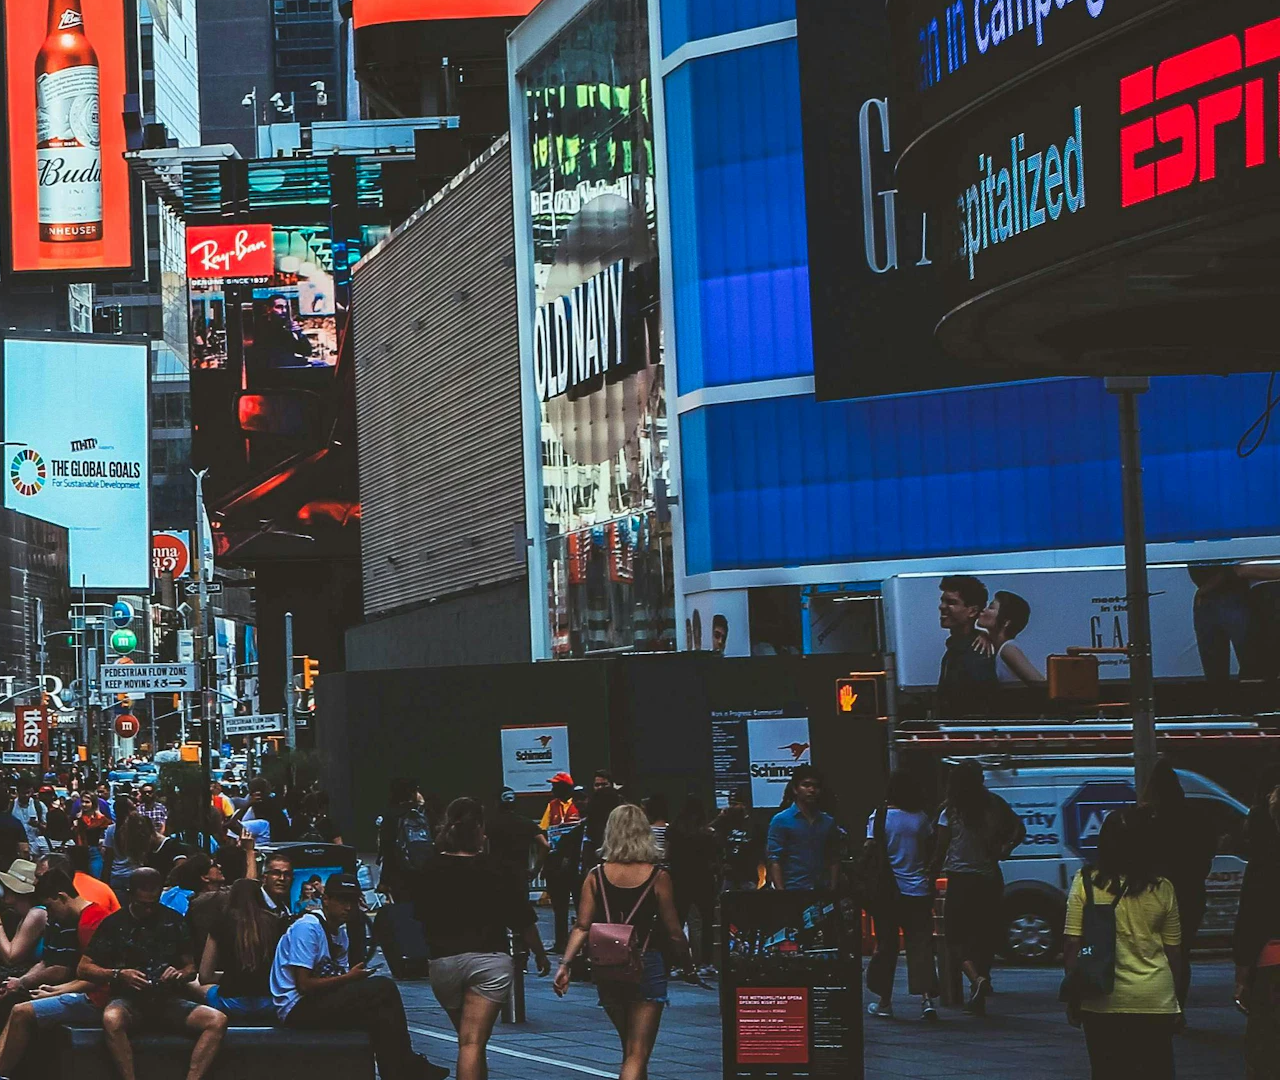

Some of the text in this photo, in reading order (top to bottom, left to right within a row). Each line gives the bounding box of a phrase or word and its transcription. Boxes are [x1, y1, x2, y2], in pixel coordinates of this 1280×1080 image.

[190, 230, 267, 271] Ray-Ban
[535, 257, 625, 403] OLD NAVY
[51, 459, 141, 479] THE GLOBAL GOALS
[52, 478, 141, 491] For Sustainable Development
[104, 666, 187, 678] PEDESTRIAN FLOW ZONE
[105, 679, 151, 689] KEEP MOVING
[23, 708, 42, 748] tkts
